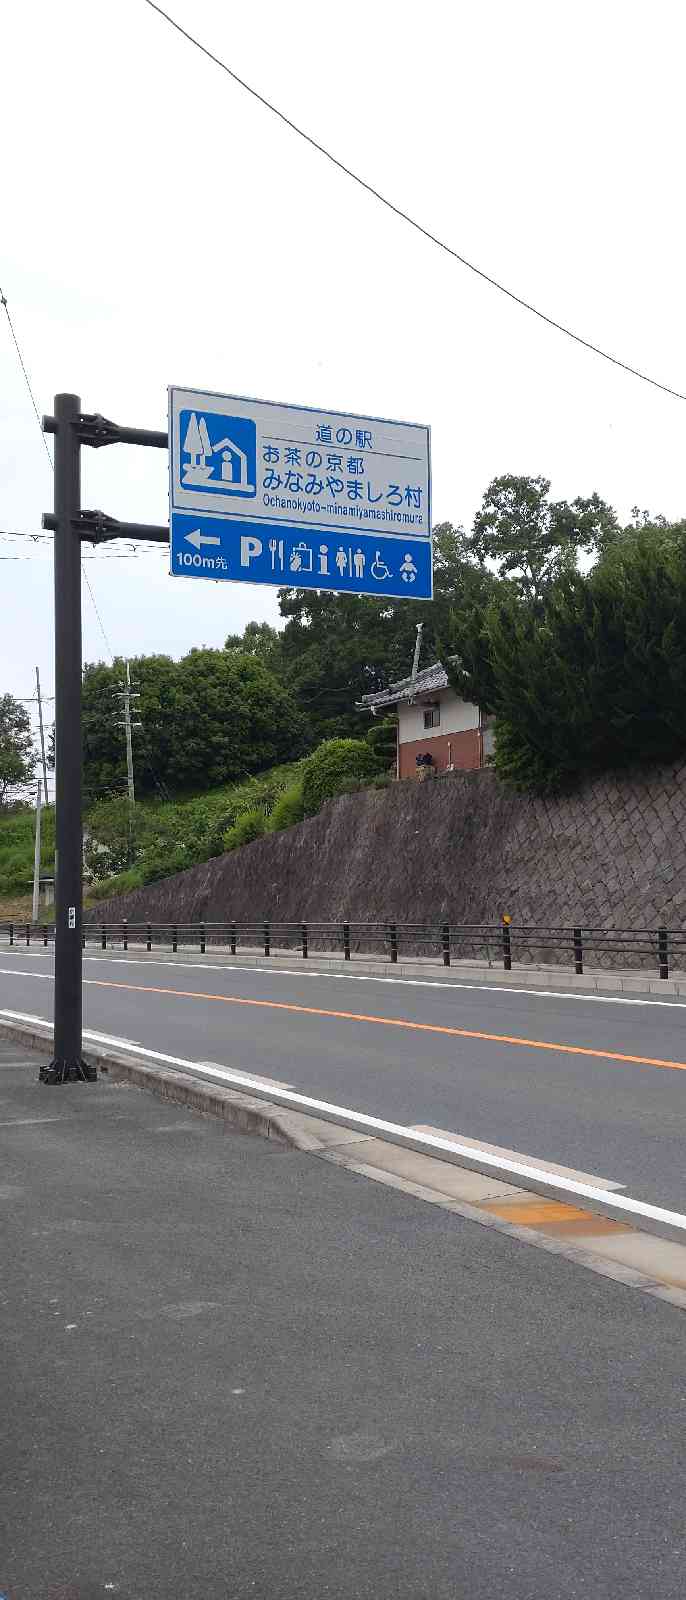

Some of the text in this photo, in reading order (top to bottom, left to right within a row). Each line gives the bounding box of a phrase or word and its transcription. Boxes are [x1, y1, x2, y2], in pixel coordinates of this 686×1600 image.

[315, 424, 374, 449] 道の駅
[262, 445, 365, 475] お茶の京都
[262, 468, 423, 509] みなみやましろ村
[262, 493, 423, 525] Ochanokyoto-minamiyamashiromura
[176, 551, 229, 570] 100m先
[240, 536, 263, 567] P
